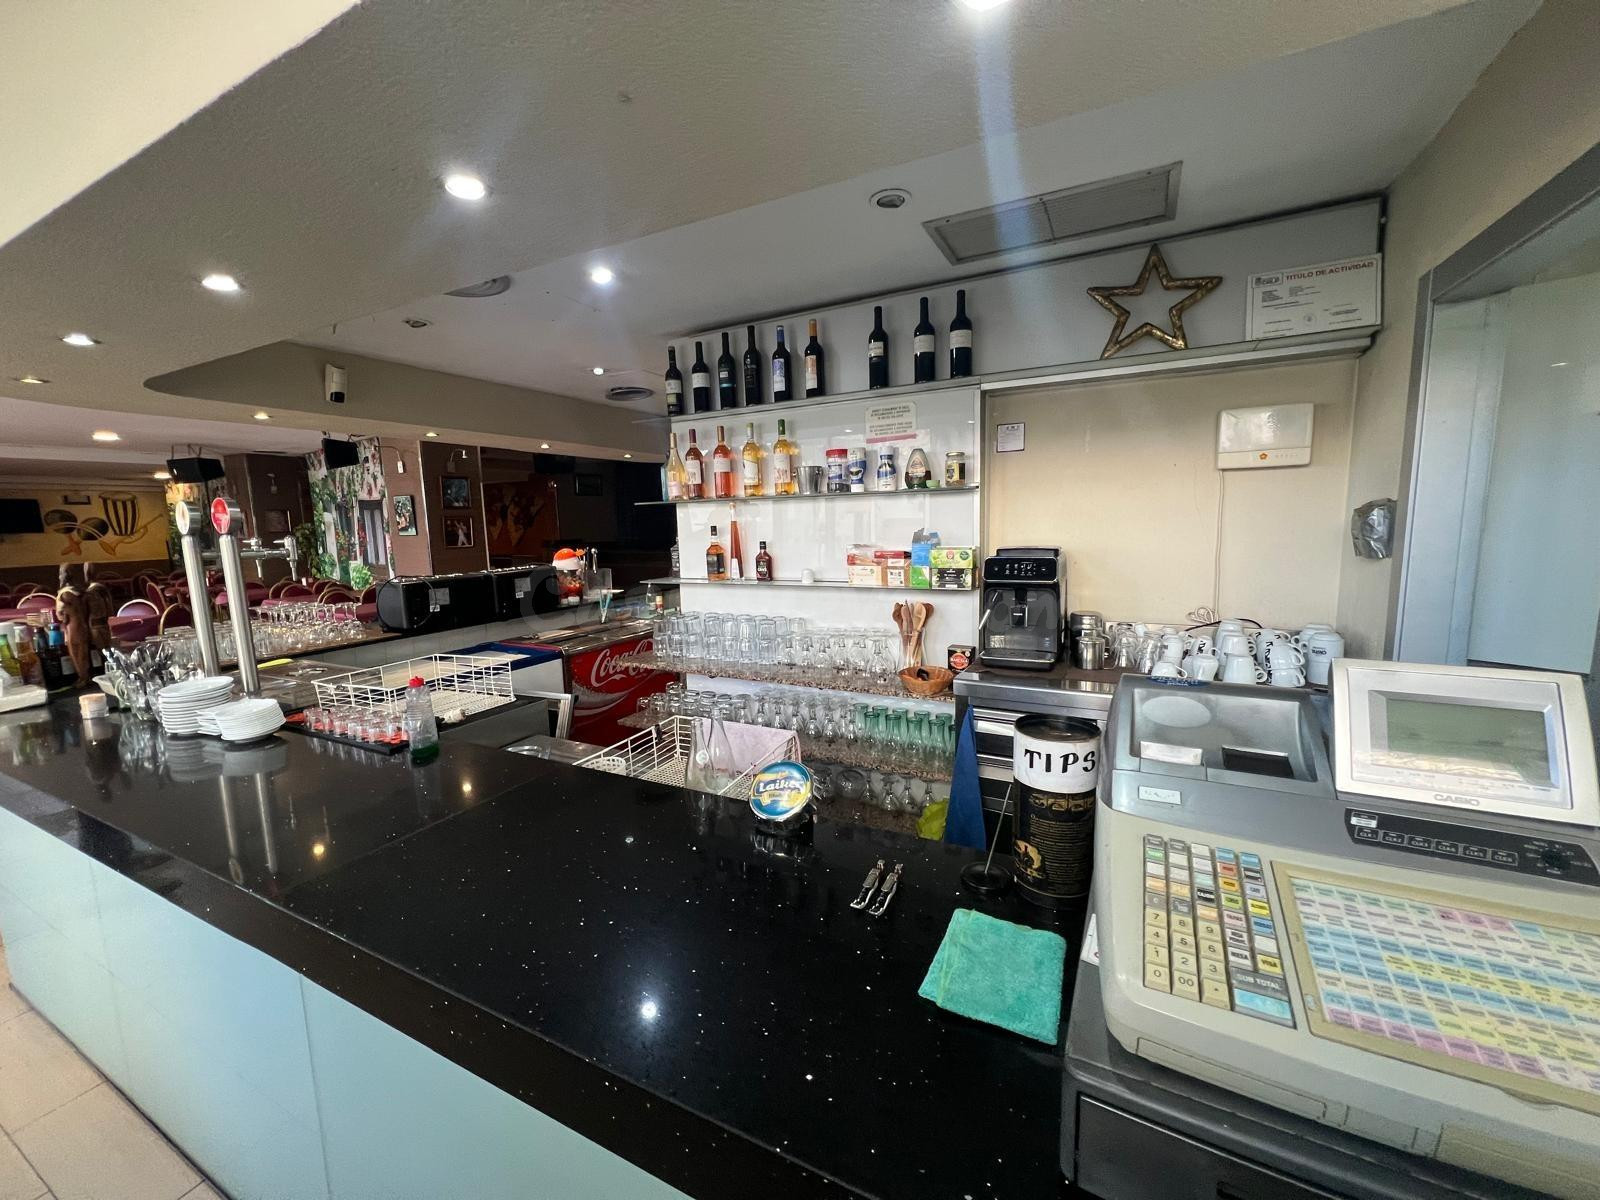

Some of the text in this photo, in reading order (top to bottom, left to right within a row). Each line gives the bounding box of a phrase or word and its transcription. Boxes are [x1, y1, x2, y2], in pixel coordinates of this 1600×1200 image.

[1315, 269, 1327, 277] DE
[1328, 261, 1374, 275] ACTIVIDAD
[1023, 748, 1096, 774] TIPS
[1433, 793, 1481, 806] CASIO
[1153, 912, 1160, 921] 7
[1179, 919, 1185, 927] 8
[1206, 926, 1214, 934] 9
[1208, 944, 1216, 953] 6
[1181, 956, 1189, 965] 2
[1209, 964, 1217, 973] 3
[1153, 969, 1162, 978] 0
[1178, 976, 1194, 987] 00
[1236, 973, 1281, 989] SUB TOTAL
